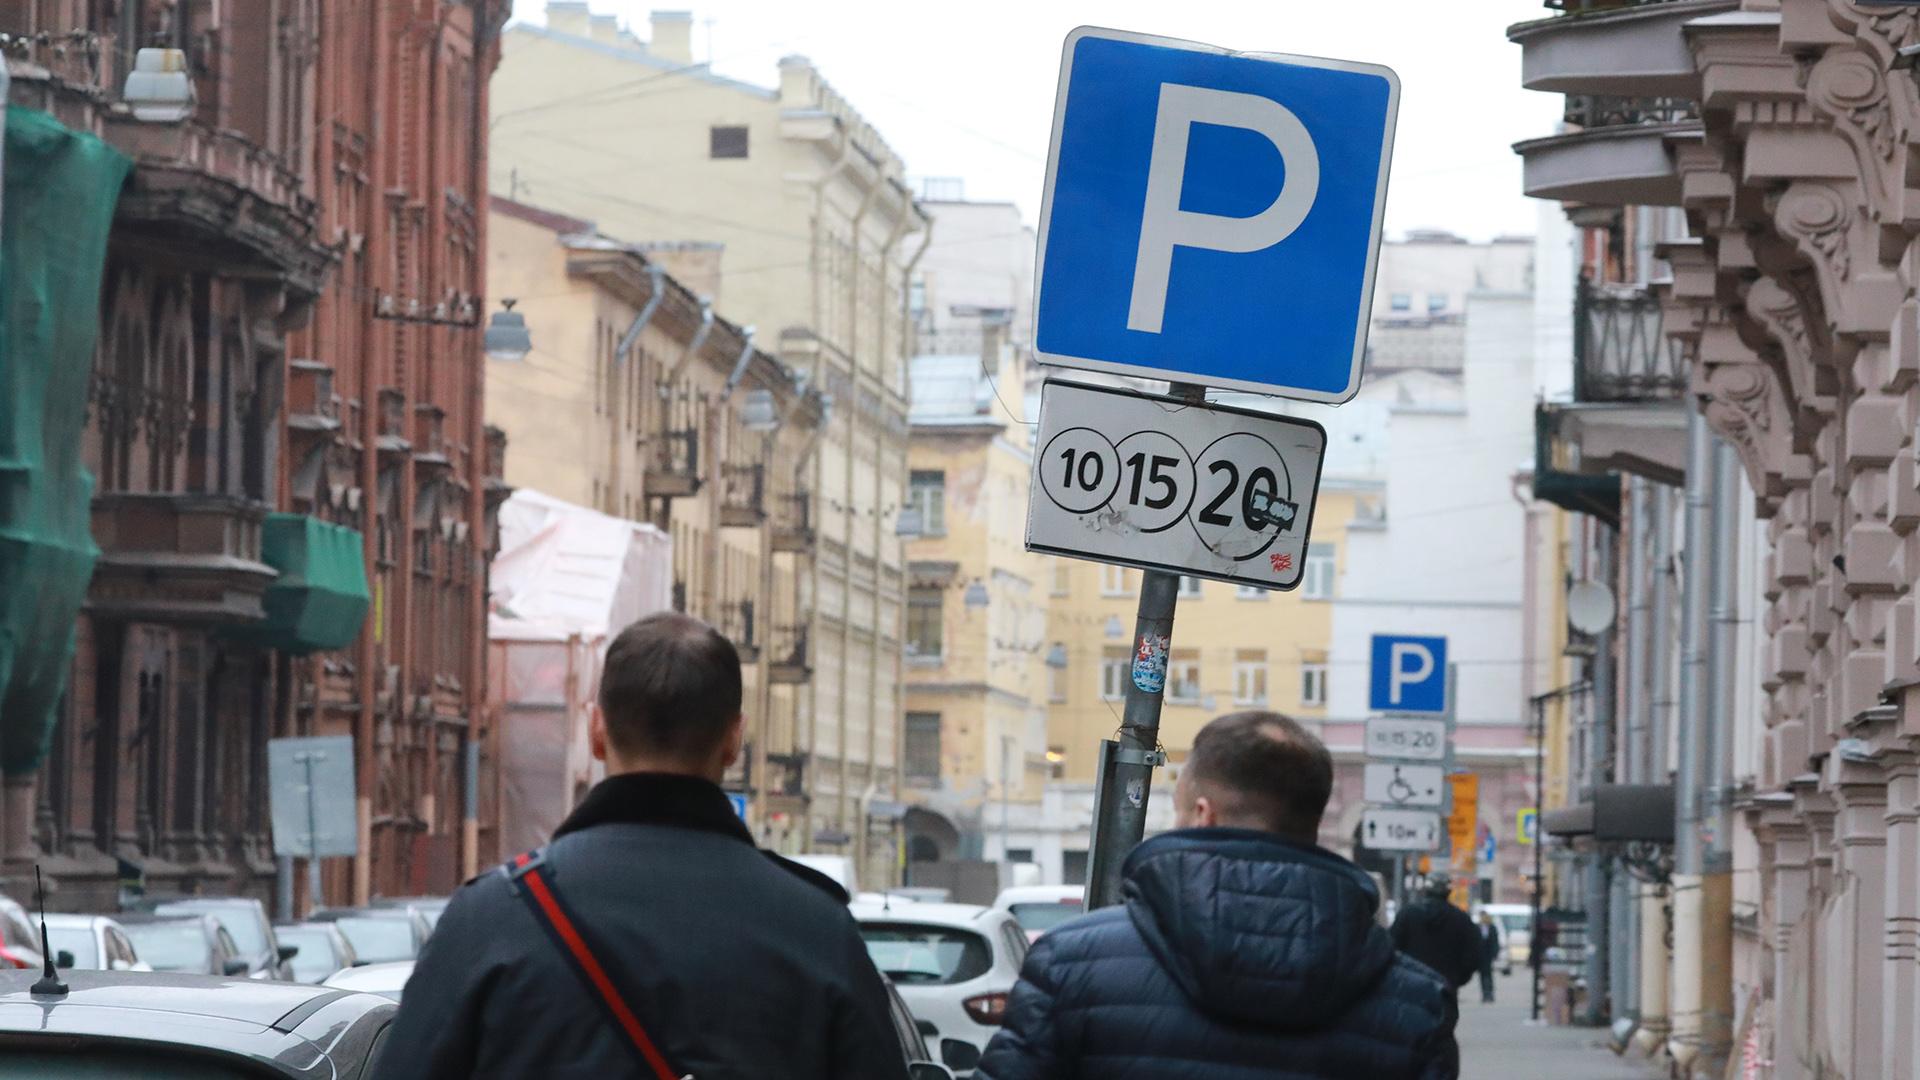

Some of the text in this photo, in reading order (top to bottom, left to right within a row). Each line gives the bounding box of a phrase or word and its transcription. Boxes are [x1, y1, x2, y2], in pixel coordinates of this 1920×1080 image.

[1126, 83, 1320, 334] P
[1060, 448, 1104, 492] 10
[1126, 452, 1180, 510] 15
[1198, 460, 1278, 532] 20
[1389, 642, 1434, 704] P
[1411, 731, 1437, 748] 20
